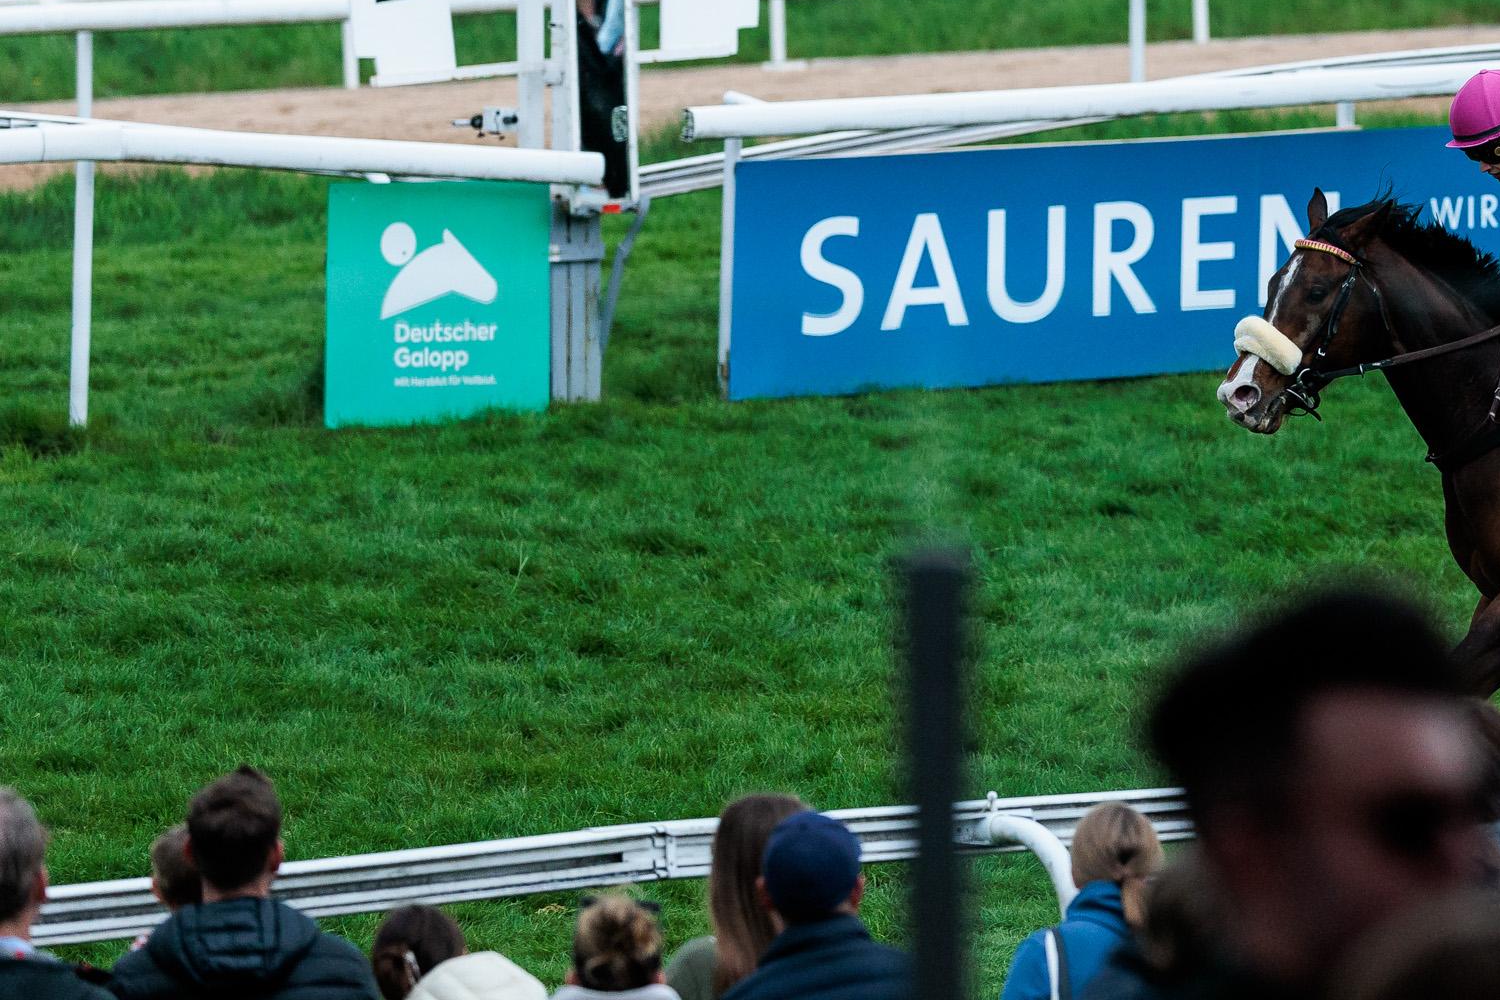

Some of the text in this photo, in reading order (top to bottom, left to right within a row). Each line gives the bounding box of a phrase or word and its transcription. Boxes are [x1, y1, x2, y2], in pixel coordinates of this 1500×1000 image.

[1429, 193, 1499, 230] WIR
[394, 320, 498, 343] Deutscher
[394, 347, 469, 371] Galopp
